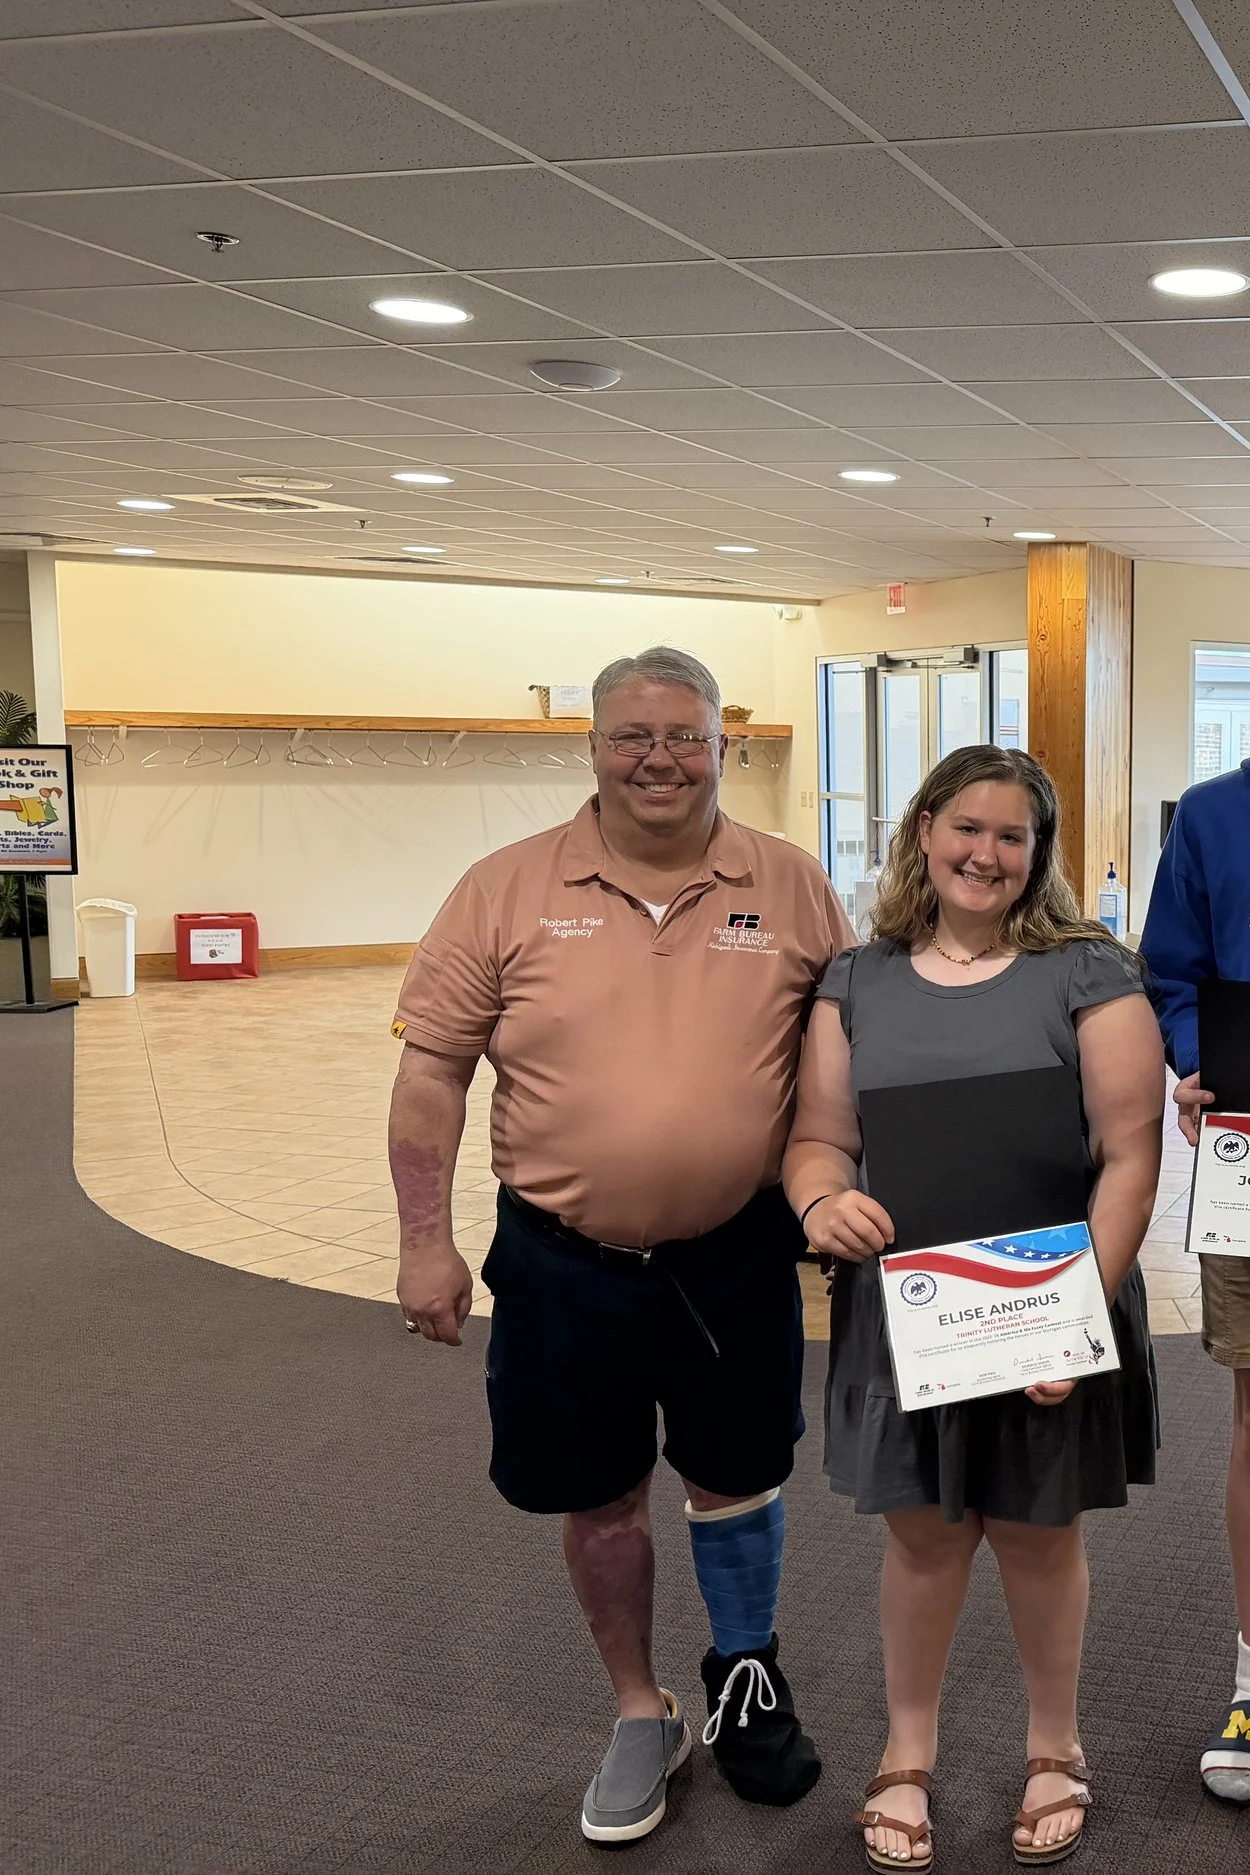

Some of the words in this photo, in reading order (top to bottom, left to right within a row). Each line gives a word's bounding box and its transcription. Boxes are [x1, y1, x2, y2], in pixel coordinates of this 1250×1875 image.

[18, 758, 47, 766] Our
[15, 769, 27, 777] &
[30, 769, 58, 778] Gift
[0, 781, 34, 790] Shop
[540, 917, 577, 928] Robert
[583, 917, 604, 927] Pike
[552, 928, 593, 938] Agency
[713, 927, 736, 937] FARM
[739, 930, 775, 940] BUREAU
[719, 936, 769, 946] INSURANCE
[758, 947, 780, 955] Company
[938, 1307, 985, 1326] ELISE
[988, 1292, 1061, 1316] ANDRUS
[980, 1318, 996, 1327] 2ND
[998, 1313, 1023, 1323] PLACE
[957, 1329, 983, 1339] TRINITY
[983, 1322, 1020, 1333] LUTHERAN
[1022, 1316, 1049, 1326] SCHOOL
